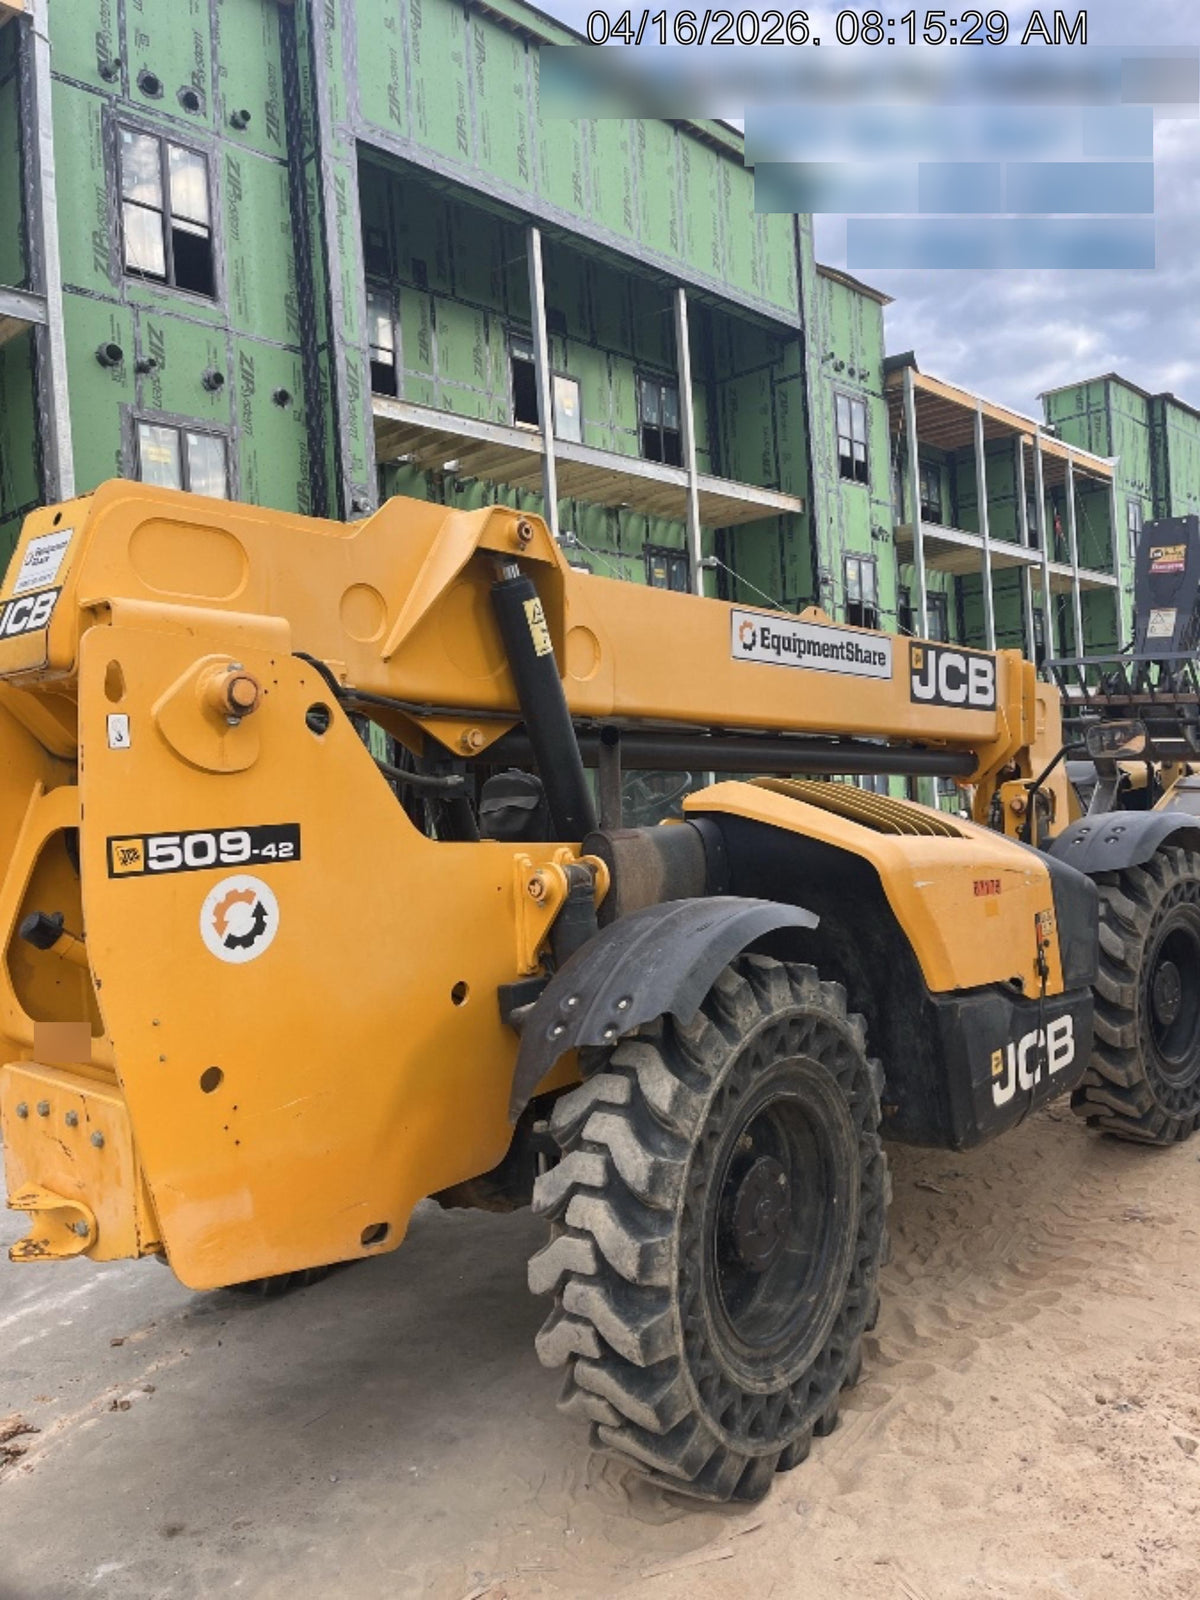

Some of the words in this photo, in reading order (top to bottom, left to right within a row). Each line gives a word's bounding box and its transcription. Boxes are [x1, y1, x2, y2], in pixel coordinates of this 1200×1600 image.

[760, 626, 887, 667] EquipmentShare
[911, 649, 995, 706] JCB
[147, 830, 295, 871] 509-42
[991, 1014, 1075, 1107] JCB
